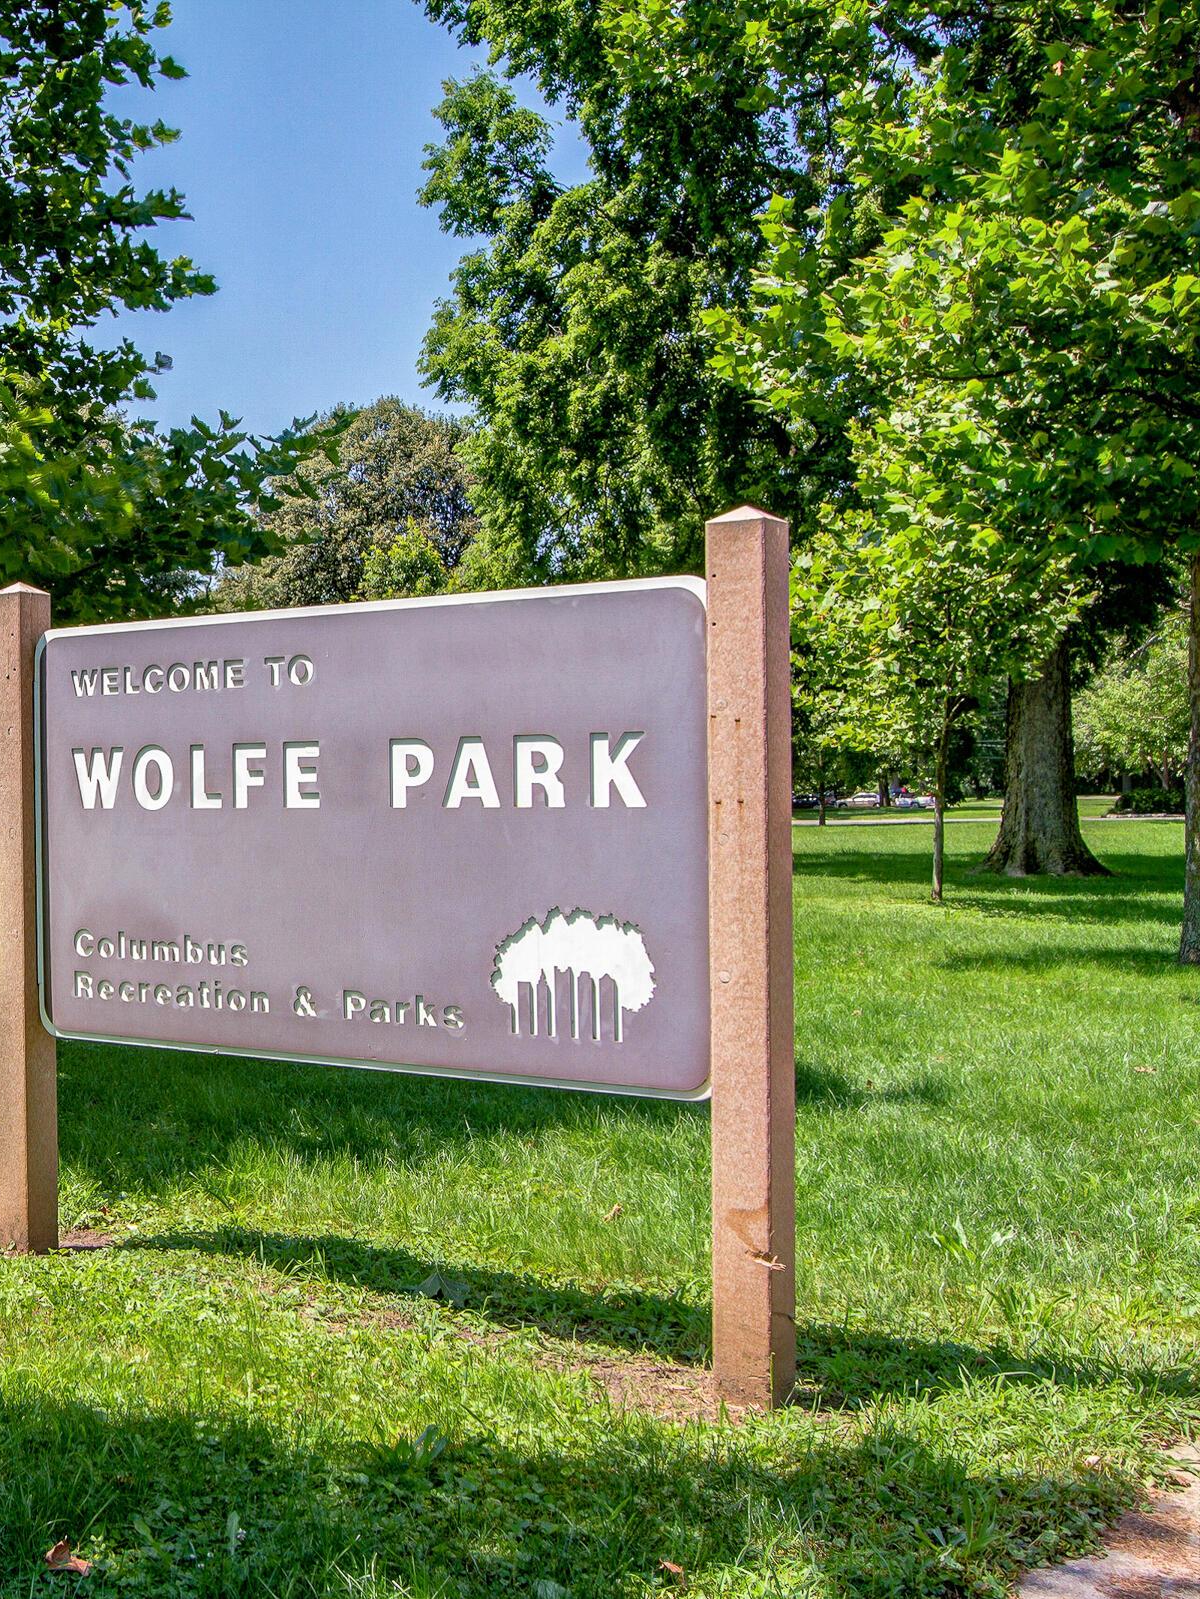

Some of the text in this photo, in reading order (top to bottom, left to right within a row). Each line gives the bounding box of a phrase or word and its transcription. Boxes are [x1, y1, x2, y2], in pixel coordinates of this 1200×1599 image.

[70, 654, 315, 697] WELCOME TO
[71, 731, 648, 811] WOLFE PARK
[73, 928, 249, 967] Columbus
[73, 971, 466, 1030] Recreation & Parks
